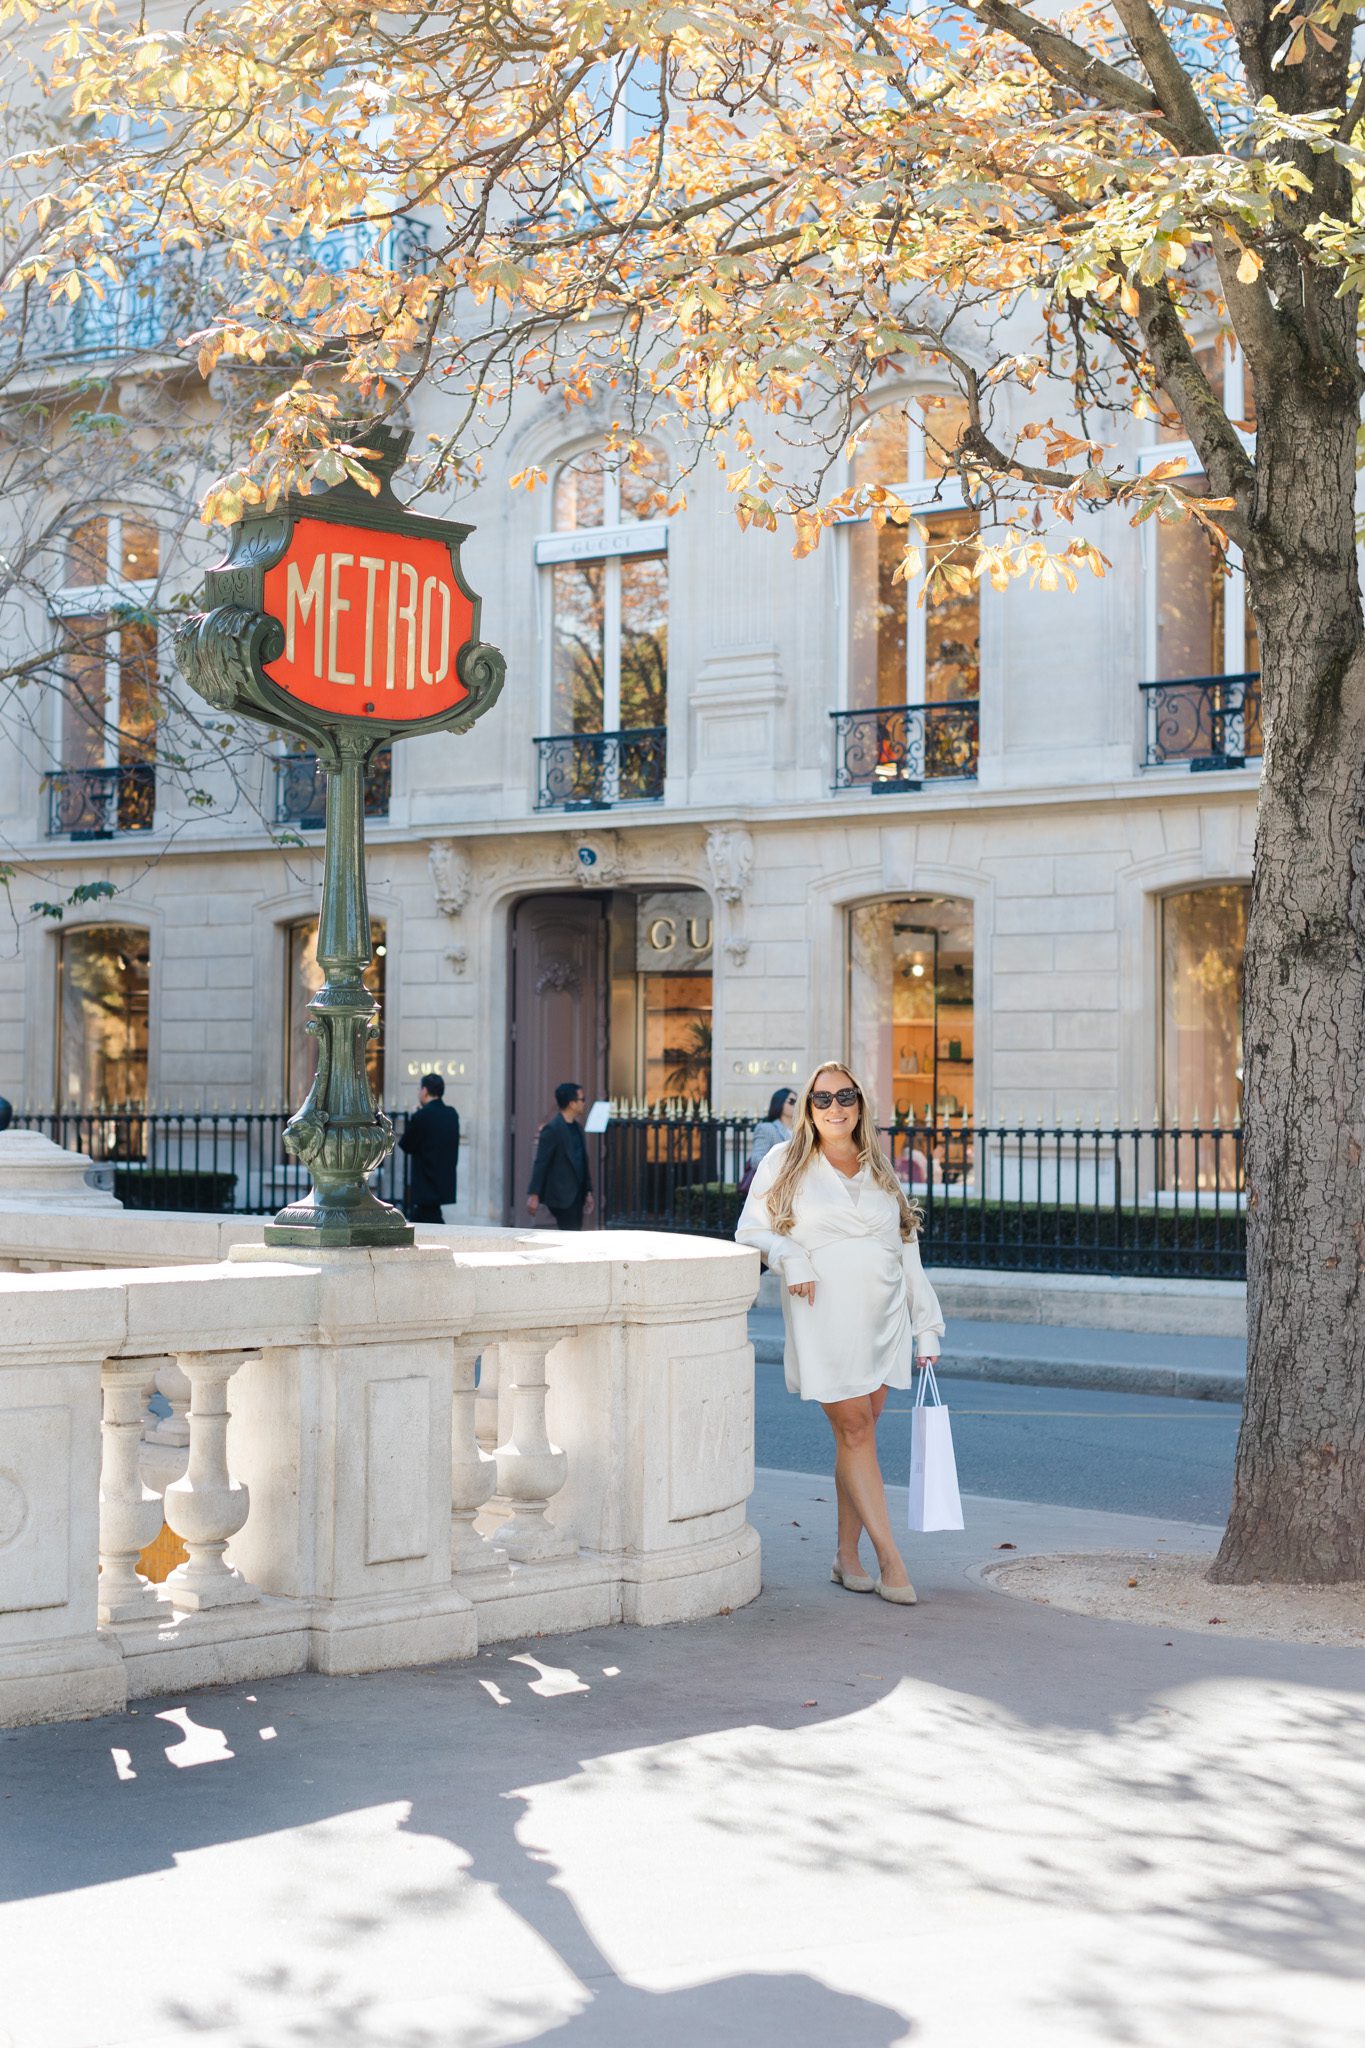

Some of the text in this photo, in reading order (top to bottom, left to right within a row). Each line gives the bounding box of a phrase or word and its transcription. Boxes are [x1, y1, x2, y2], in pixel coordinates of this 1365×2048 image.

[571, 536, 631, 554] GUCCI
[286, 552, 451, 690] METRO
[407, 1061, 465, 1075] GUCCI
[733, 1061, 797, 1075] GUCCI
